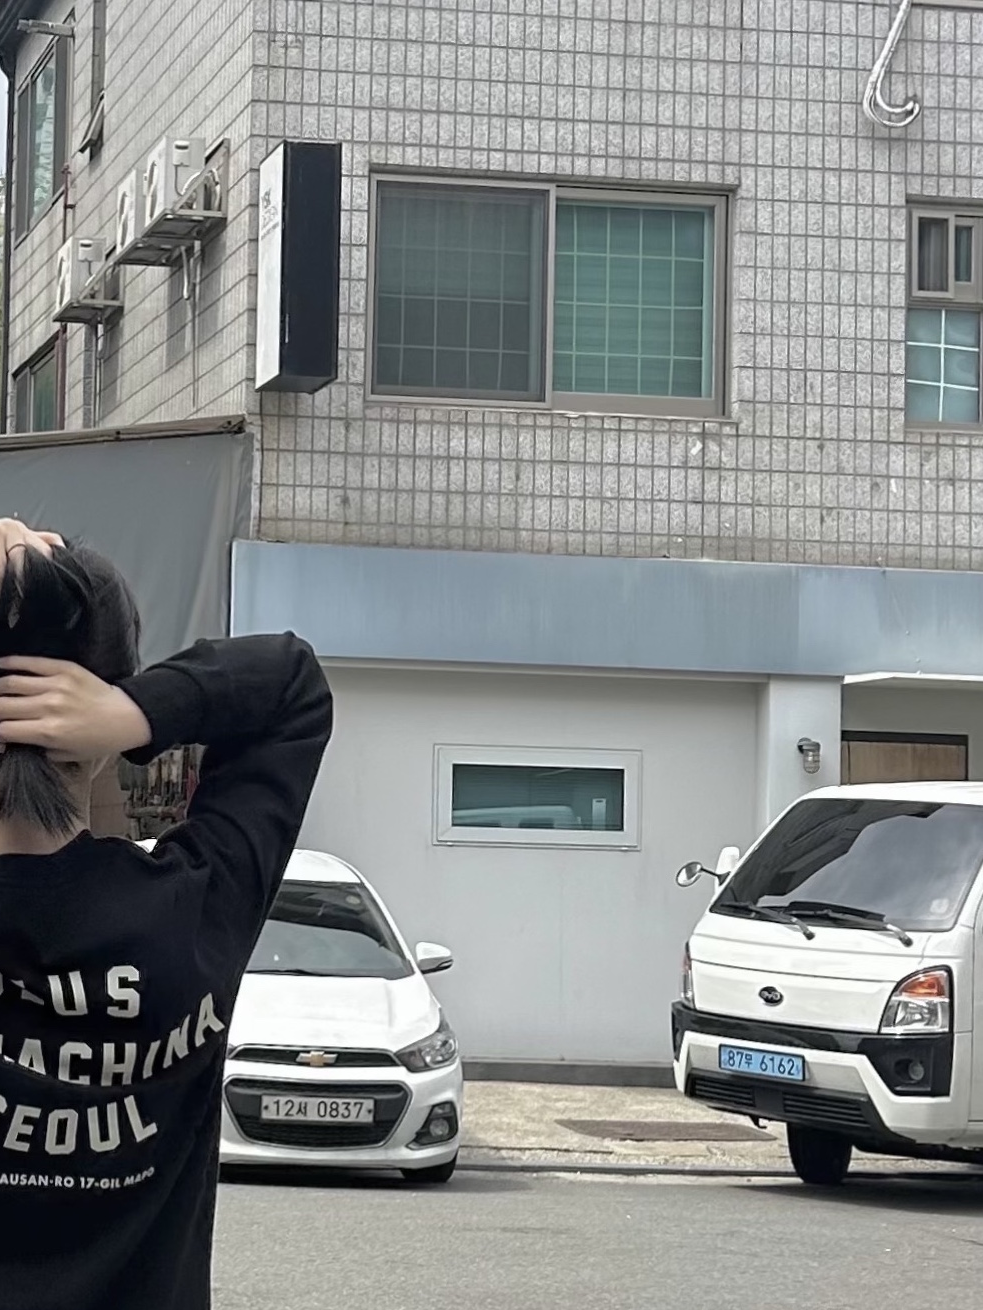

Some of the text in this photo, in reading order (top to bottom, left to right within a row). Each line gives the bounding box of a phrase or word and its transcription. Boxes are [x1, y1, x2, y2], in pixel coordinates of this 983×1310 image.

[728, 1049, 795, 1076] 87무 6162
[273, 1099, 364, 1119] 12서 0837
[79, 1176, 121, 1190] 17-GIL
[123, 1166, 155, 1187] MAPO
